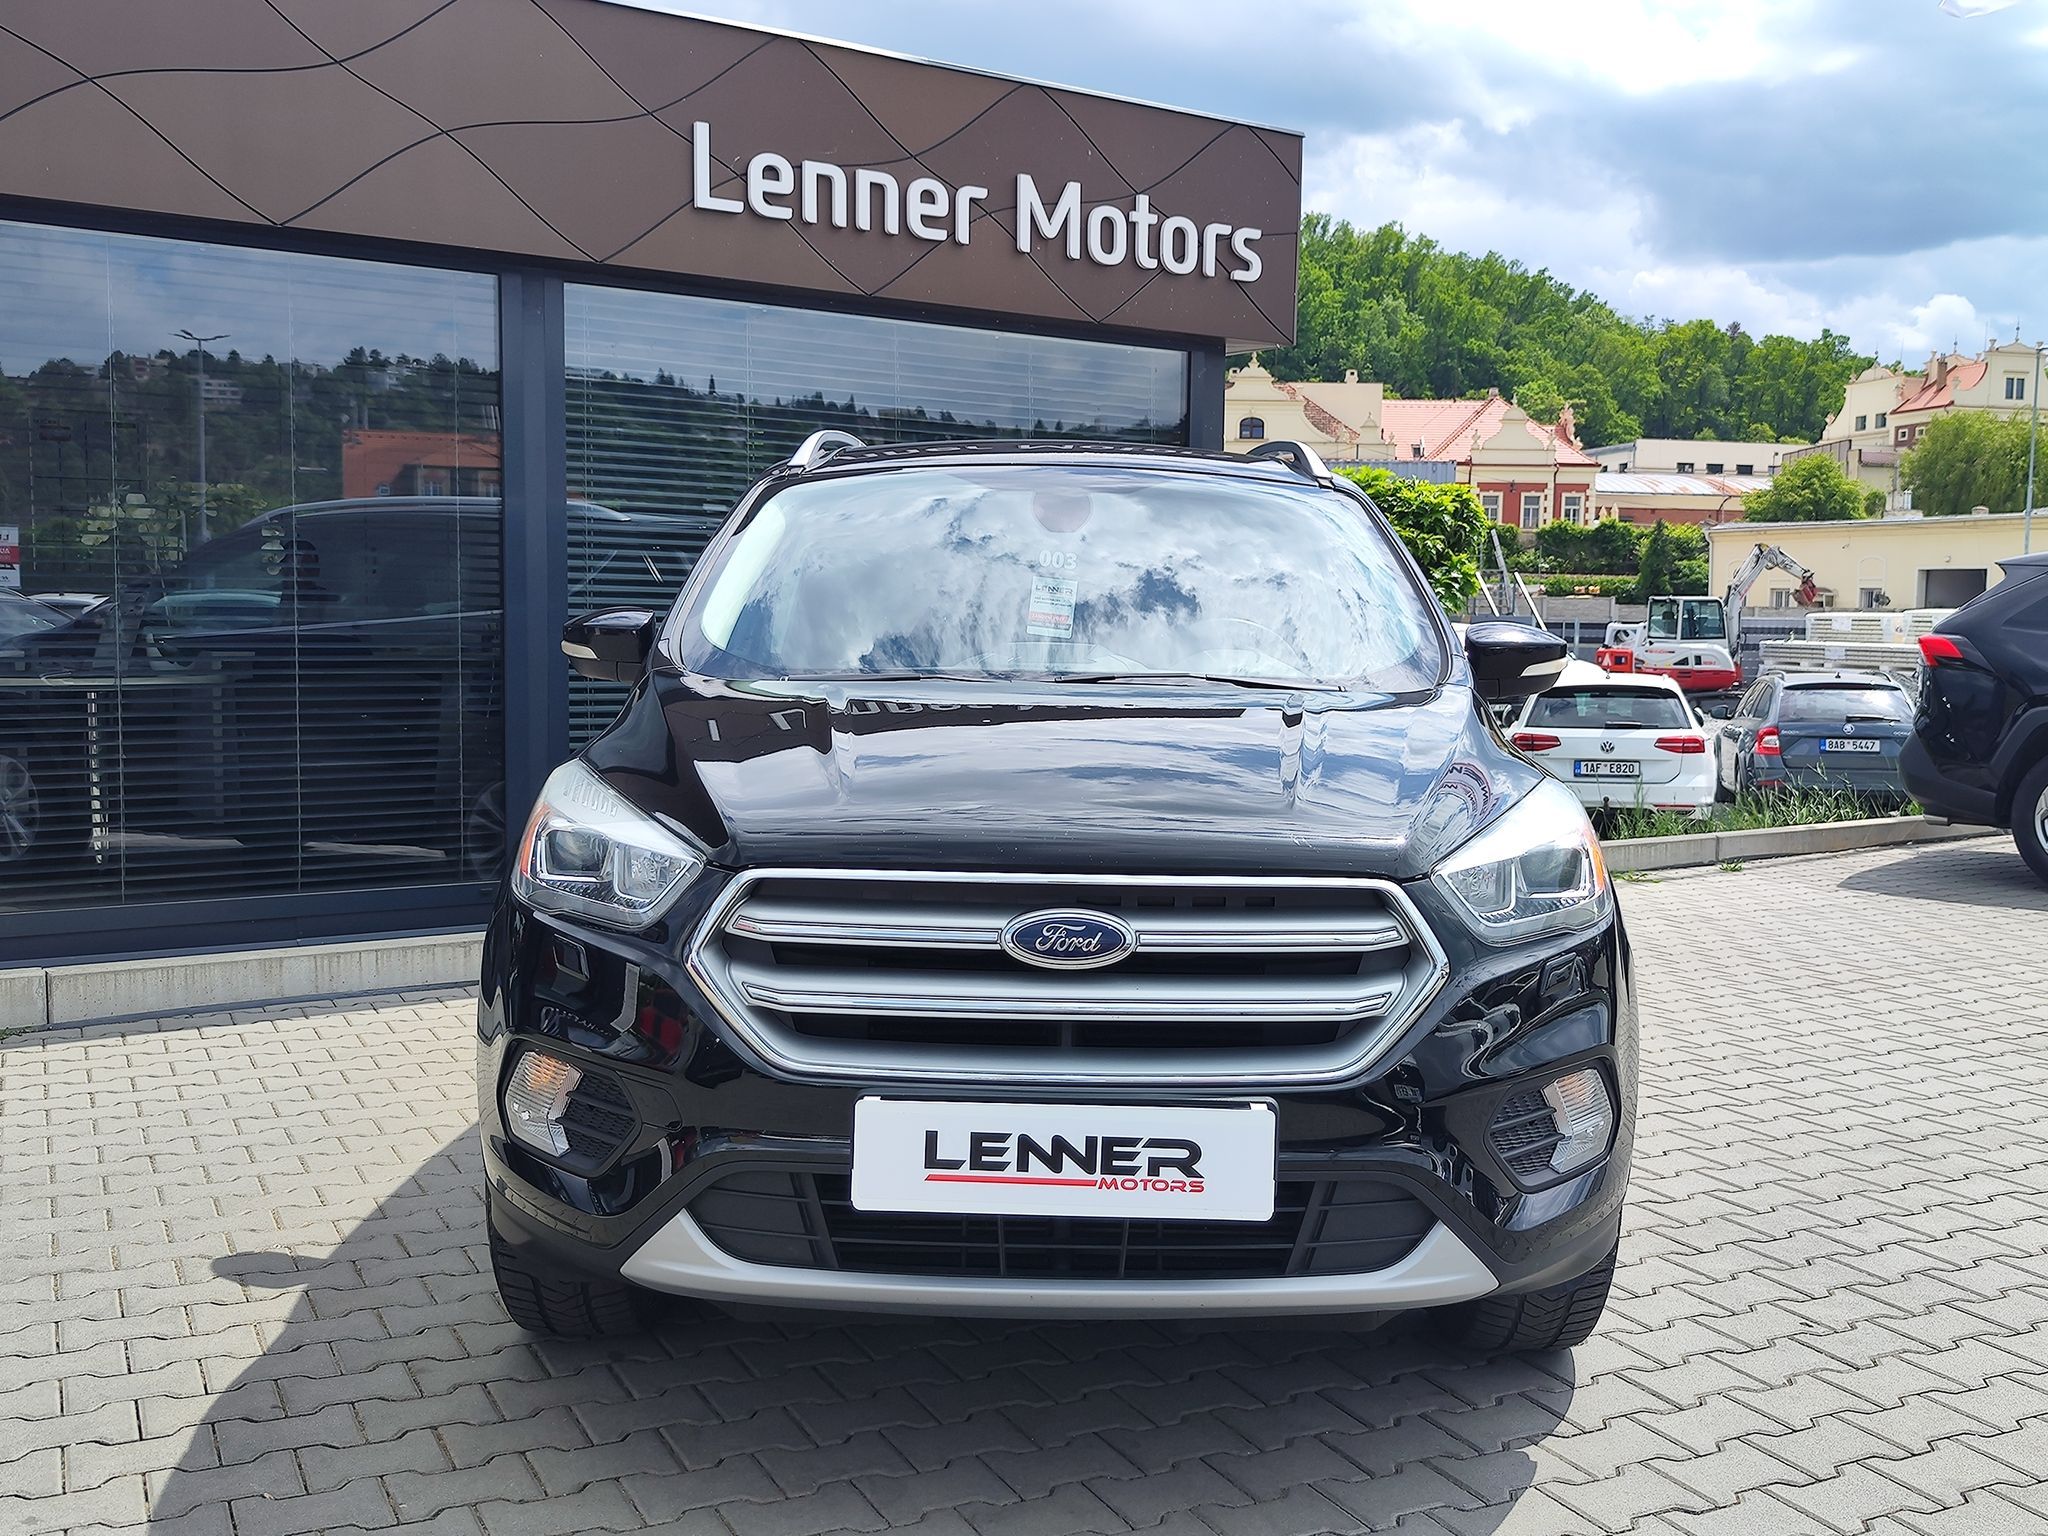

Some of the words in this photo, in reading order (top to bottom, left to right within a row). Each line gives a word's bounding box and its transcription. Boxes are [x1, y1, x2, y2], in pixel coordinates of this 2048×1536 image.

[693, 121, 989, 246] Lenner
[1016, 173, 1264, 284] Motors
[1040, 550, 1077, 569] 003
[1827, 740, 1846, 750] 8AB
[1852, 741, 1876, 751] 5447
[1583, 763, 1602, 774] 1AF
[1609, 764, 1635, 774] E820
[1035, 923, 1102, 952] Ford
[924, 1130, 1205, 1178] LENNER
[1098, 1177, 1205, 1193] MOTORS
